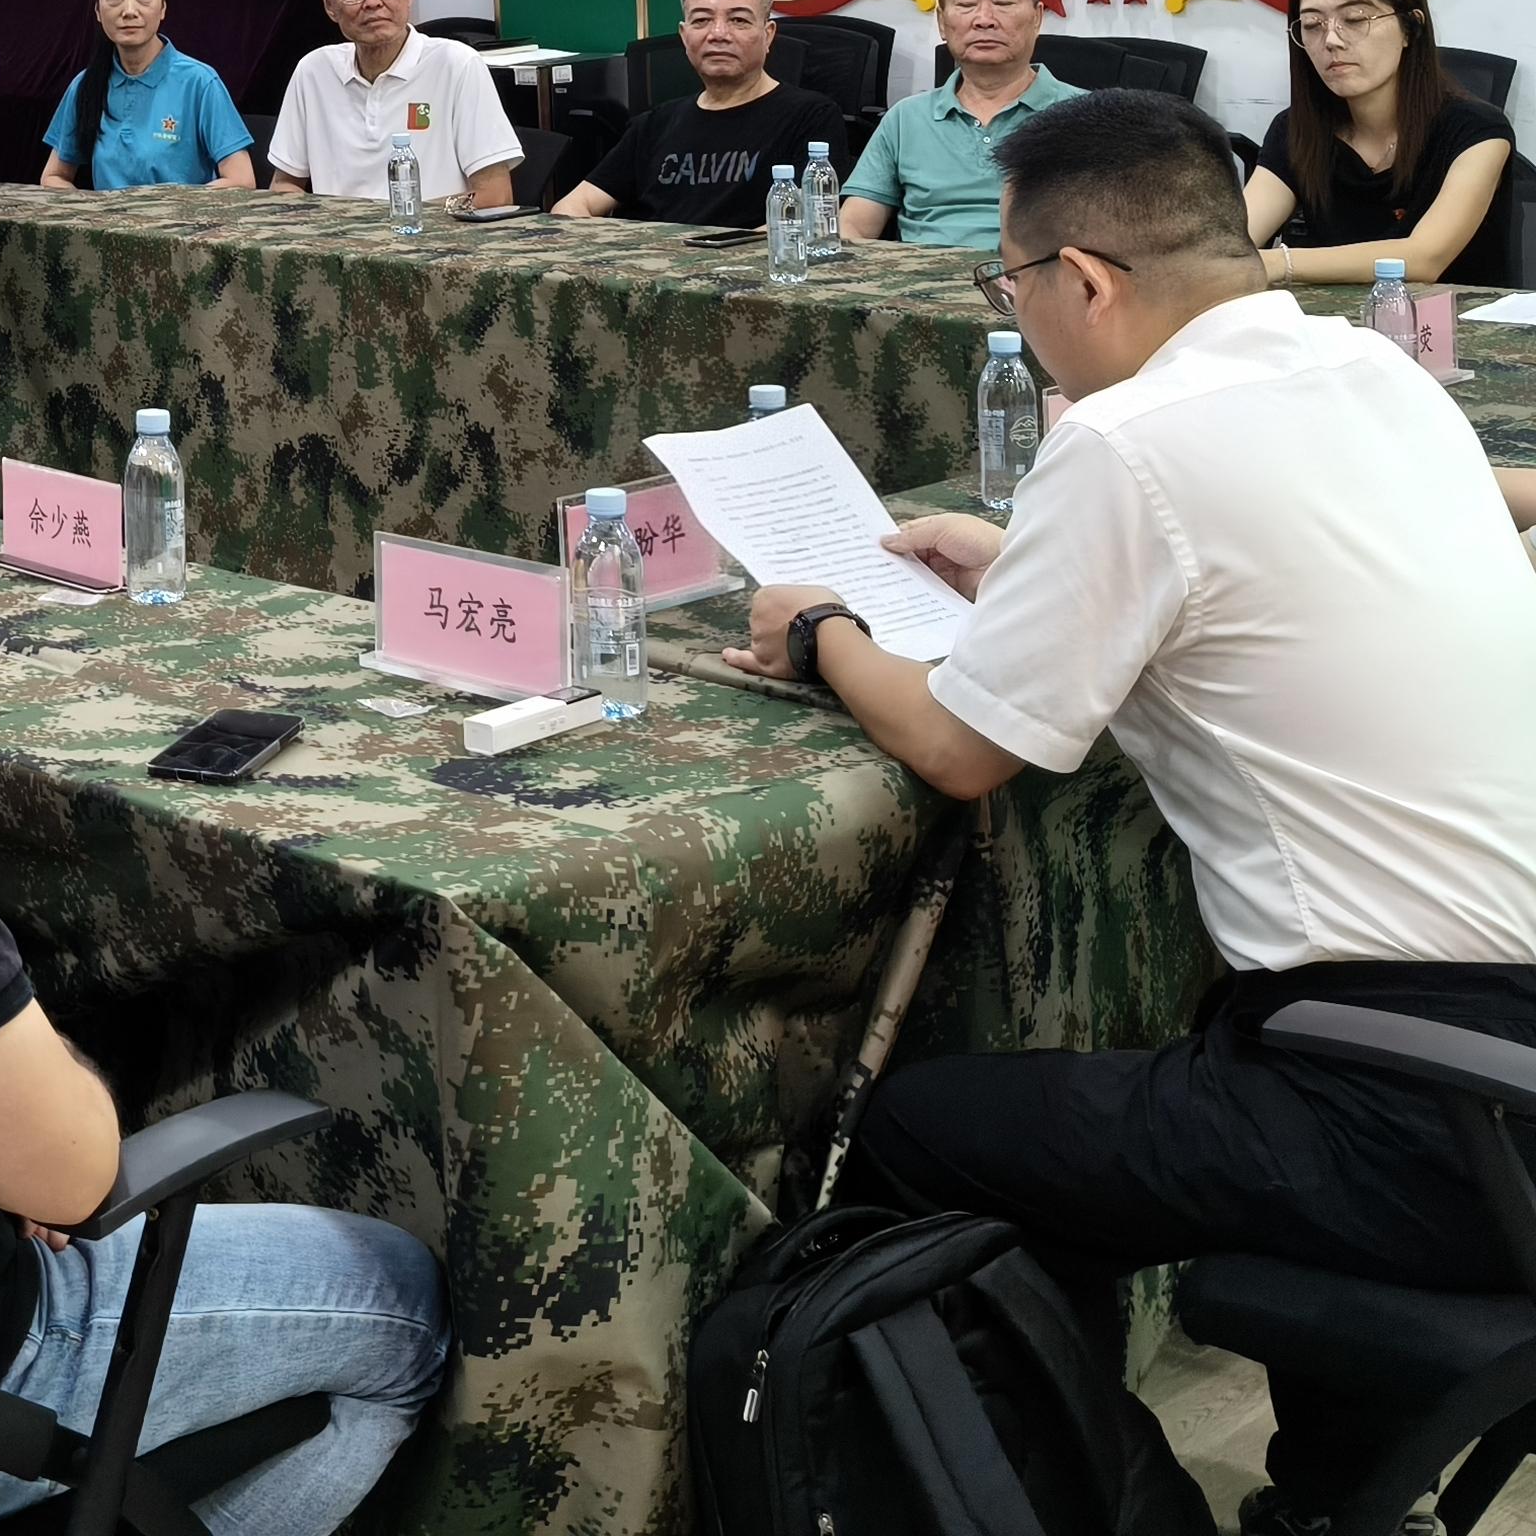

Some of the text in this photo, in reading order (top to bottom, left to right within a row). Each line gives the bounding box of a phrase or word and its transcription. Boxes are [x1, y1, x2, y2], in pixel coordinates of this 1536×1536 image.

[657, 149, 761, 186] CALVIN
[423, 586, 517, 644] 马宏亮
